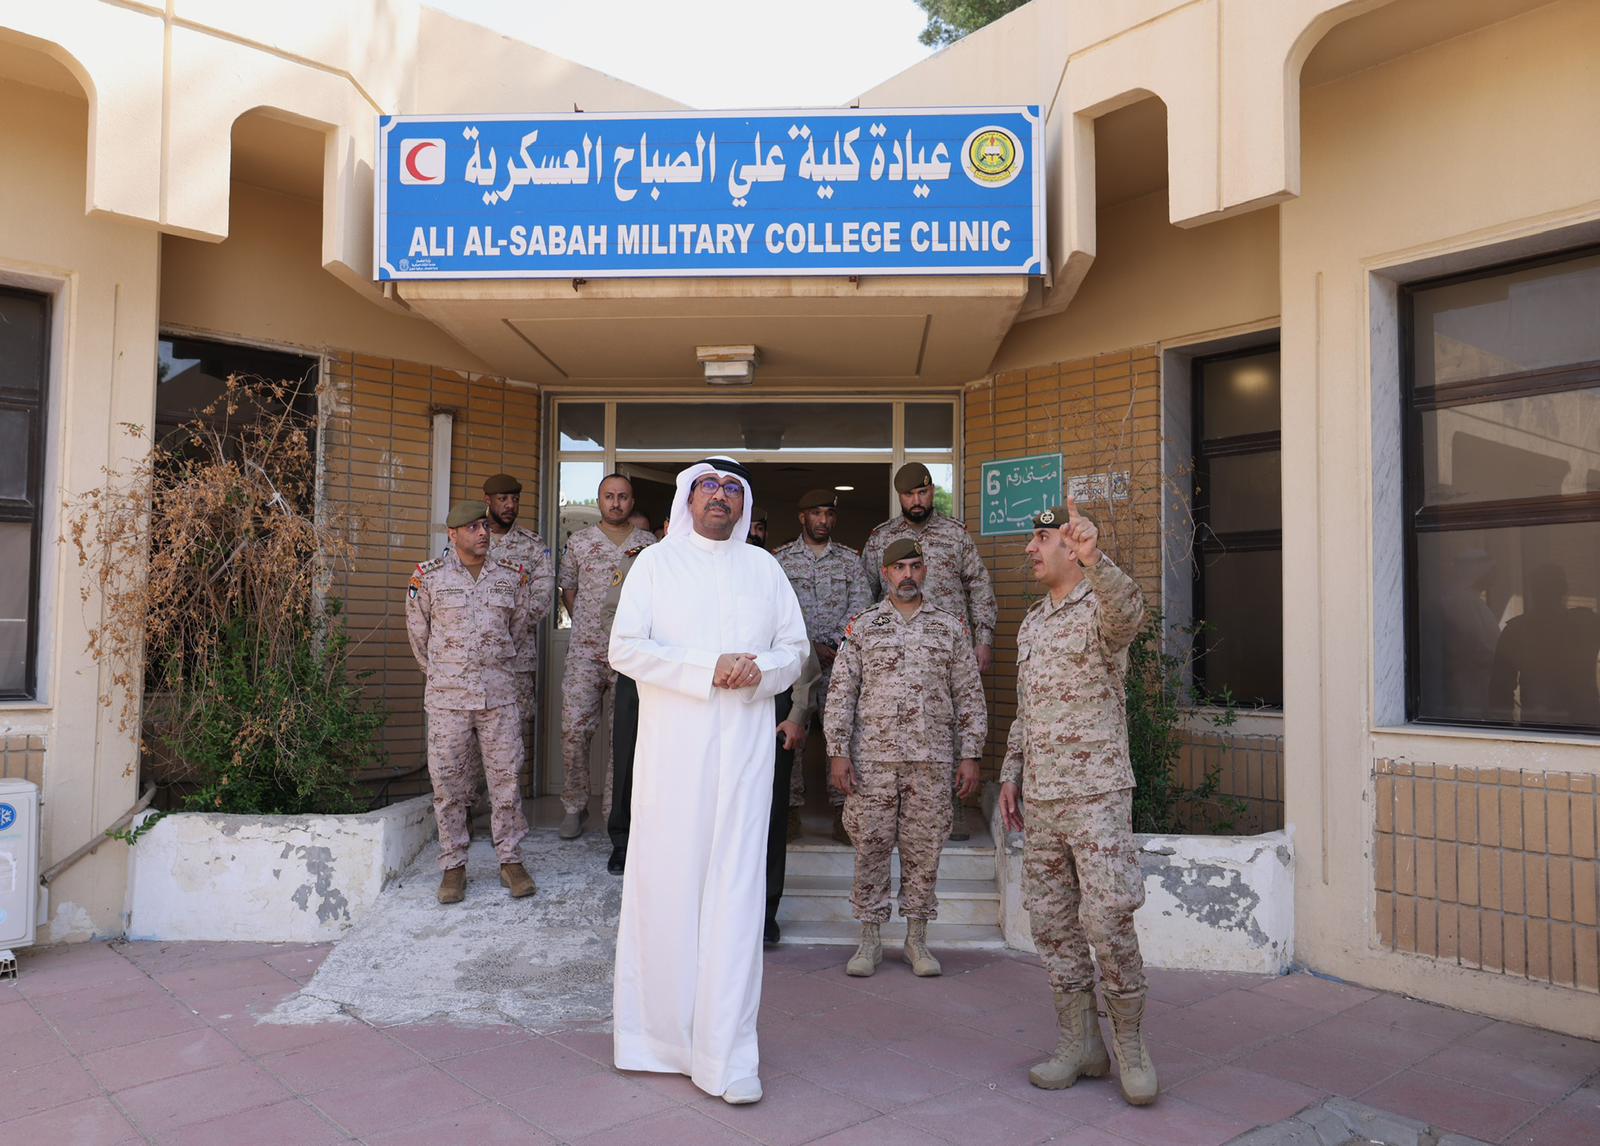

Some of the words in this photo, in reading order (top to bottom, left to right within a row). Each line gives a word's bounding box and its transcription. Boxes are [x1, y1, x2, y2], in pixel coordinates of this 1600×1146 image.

[462, 126, 603, 206] العسكرية
[613, 131, 716, 202] الصباح
[728, 131, 787, 208] علي
[787, 124, 861, 200] كلية
[869, 123, 952, 199] عيادة
[408, 226, 454, 257] ALI
[463, 225, 608, 257] AL-SABAH
[617, 223, 755, 255] MILITARY
[765, 222, 901, 254] COLLEGE
[910, 220, 1011, 252] CLINIC
[987, 470, 1001, 495] 6
[1006, 467, 1022, 488] رقم
